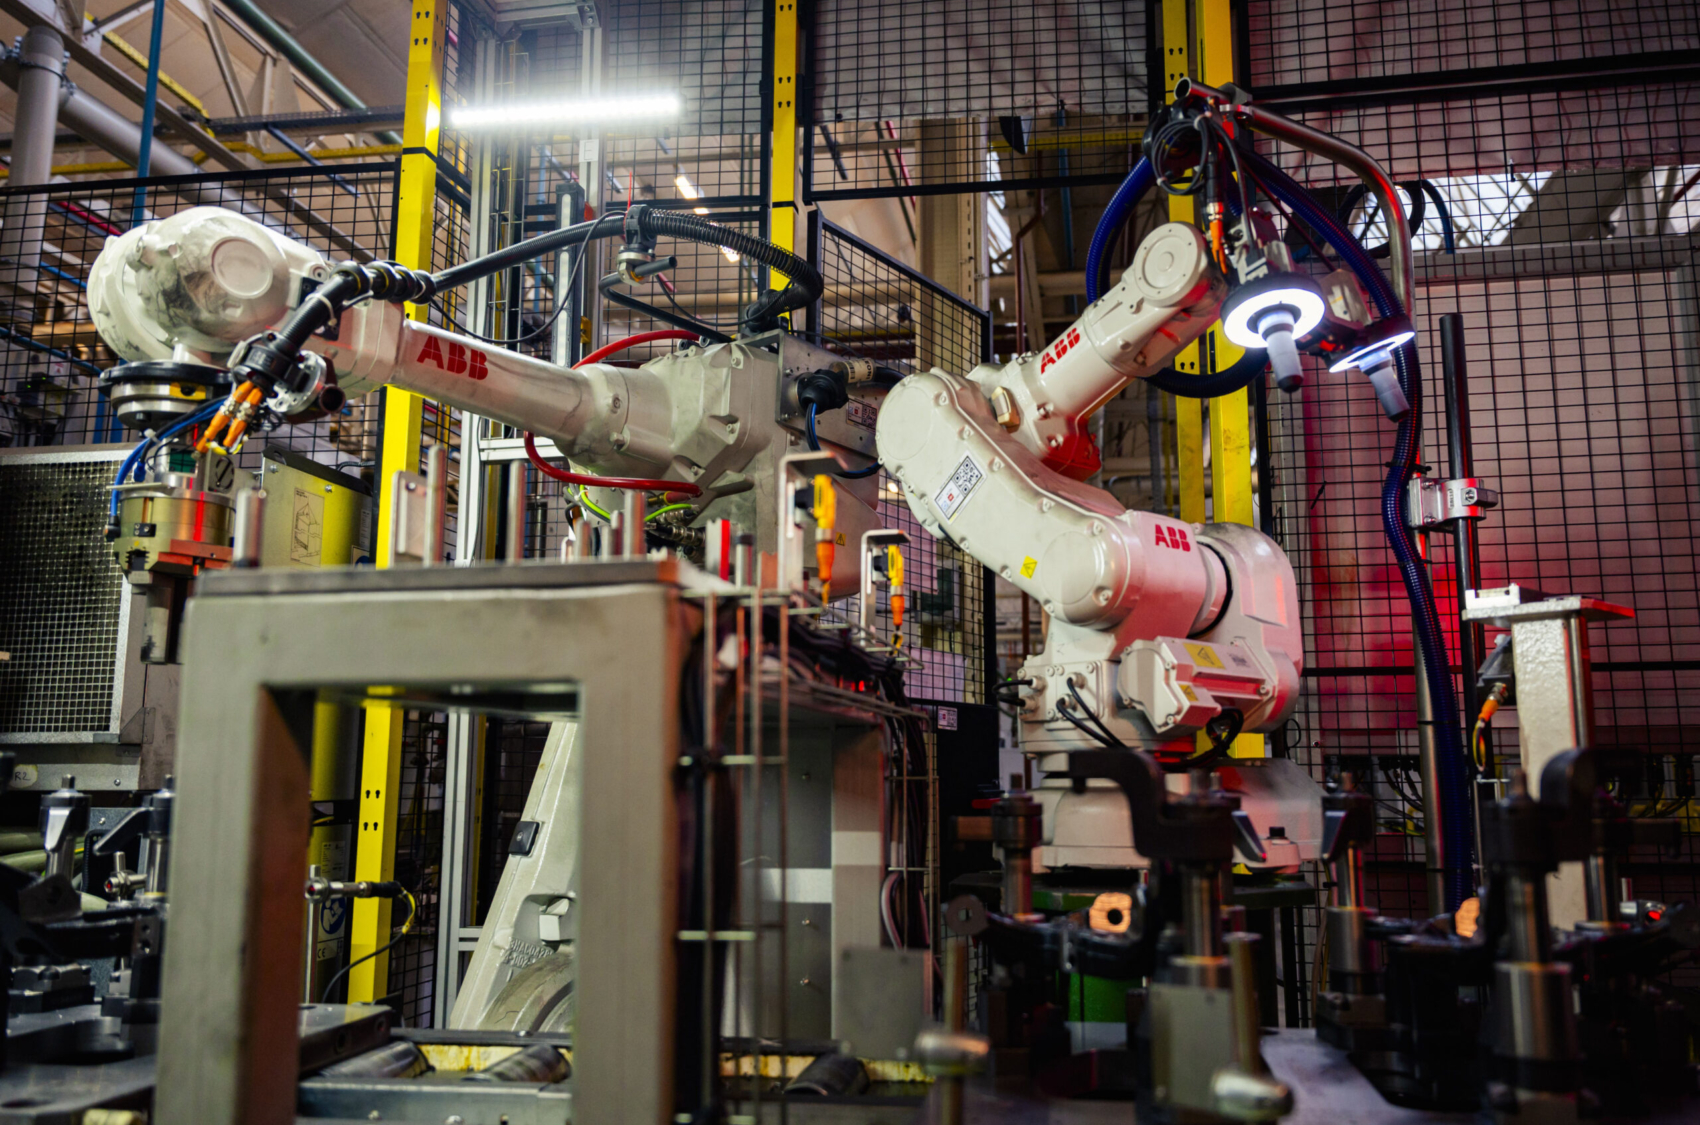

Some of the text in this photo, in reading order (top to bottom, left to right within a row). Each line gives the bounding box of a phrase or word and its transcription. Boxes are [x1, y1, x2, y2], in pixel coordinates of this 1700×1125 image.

[416, 335, 489, 380] ABB
[1041, 327, 1080, 375] ABB
[1155, 524, 1191, 552] ABB
[14, 771, 31, 781] R2
